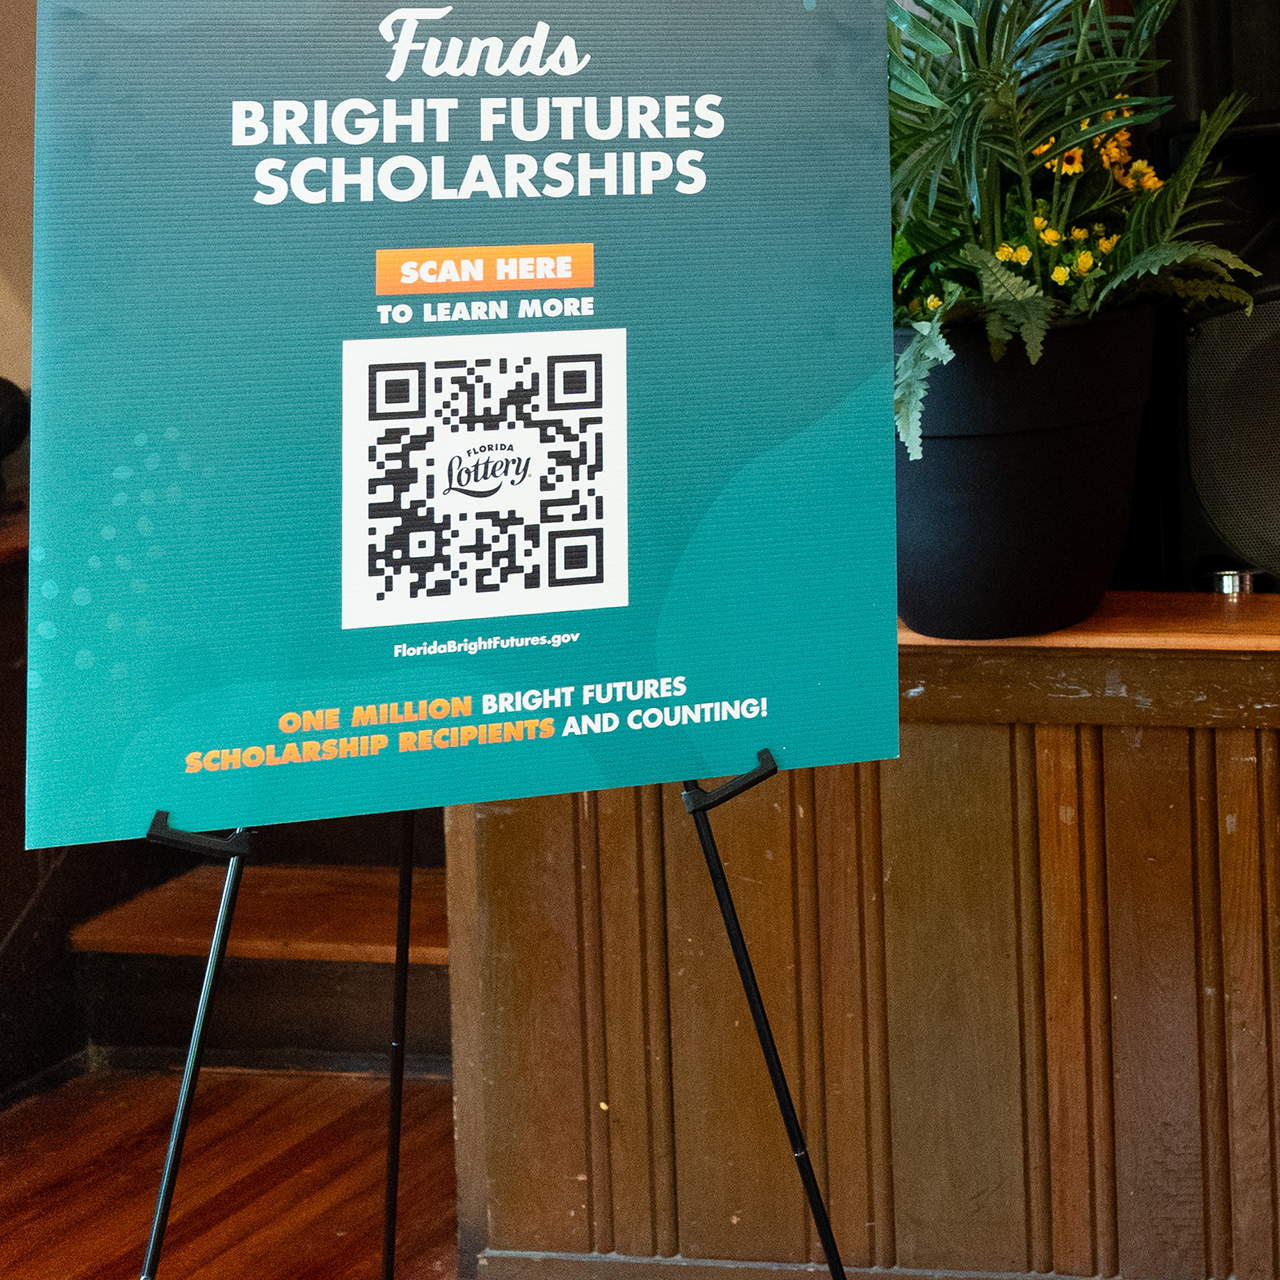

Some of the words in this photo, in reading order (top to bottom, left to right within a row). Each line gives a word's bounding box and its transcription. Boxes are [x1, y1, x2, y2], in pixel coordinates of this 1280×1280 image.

[378, 5, 591, 82] Funds
[231, 97, 458, 146] BRIGHT
[479, 94, 725, 142] FUTURES
[252, 150, 707, 205] SCHOLARSHIPS
[400, 259, 484, 284] SCAN
[497, 256, 572, 280] HERE
[377, 303, 413, 324] TO
[423, 300, 508, 323] LEARN
[518, 297, 594, 318] MORE
[466, 443, 514, 457] FLORIDA
[442, 455, 532, 498] Lottery
[393, 631, 580, 658] FloridaBrightFutures.gov
[278, 709, 340, 734] ONE
[351, 696, 472, 728] MILLION
[481, 686, 575, 716] BRIGHT
[582, 676, 687, 704] FUTURES
[185, 735, 388, 774] SCHOLARSHIP
[399, 718, 555, 754] RECIPIENTS
[562, 714, 619, 738] AND
[626, 697, 768, 731] COUNTING!
